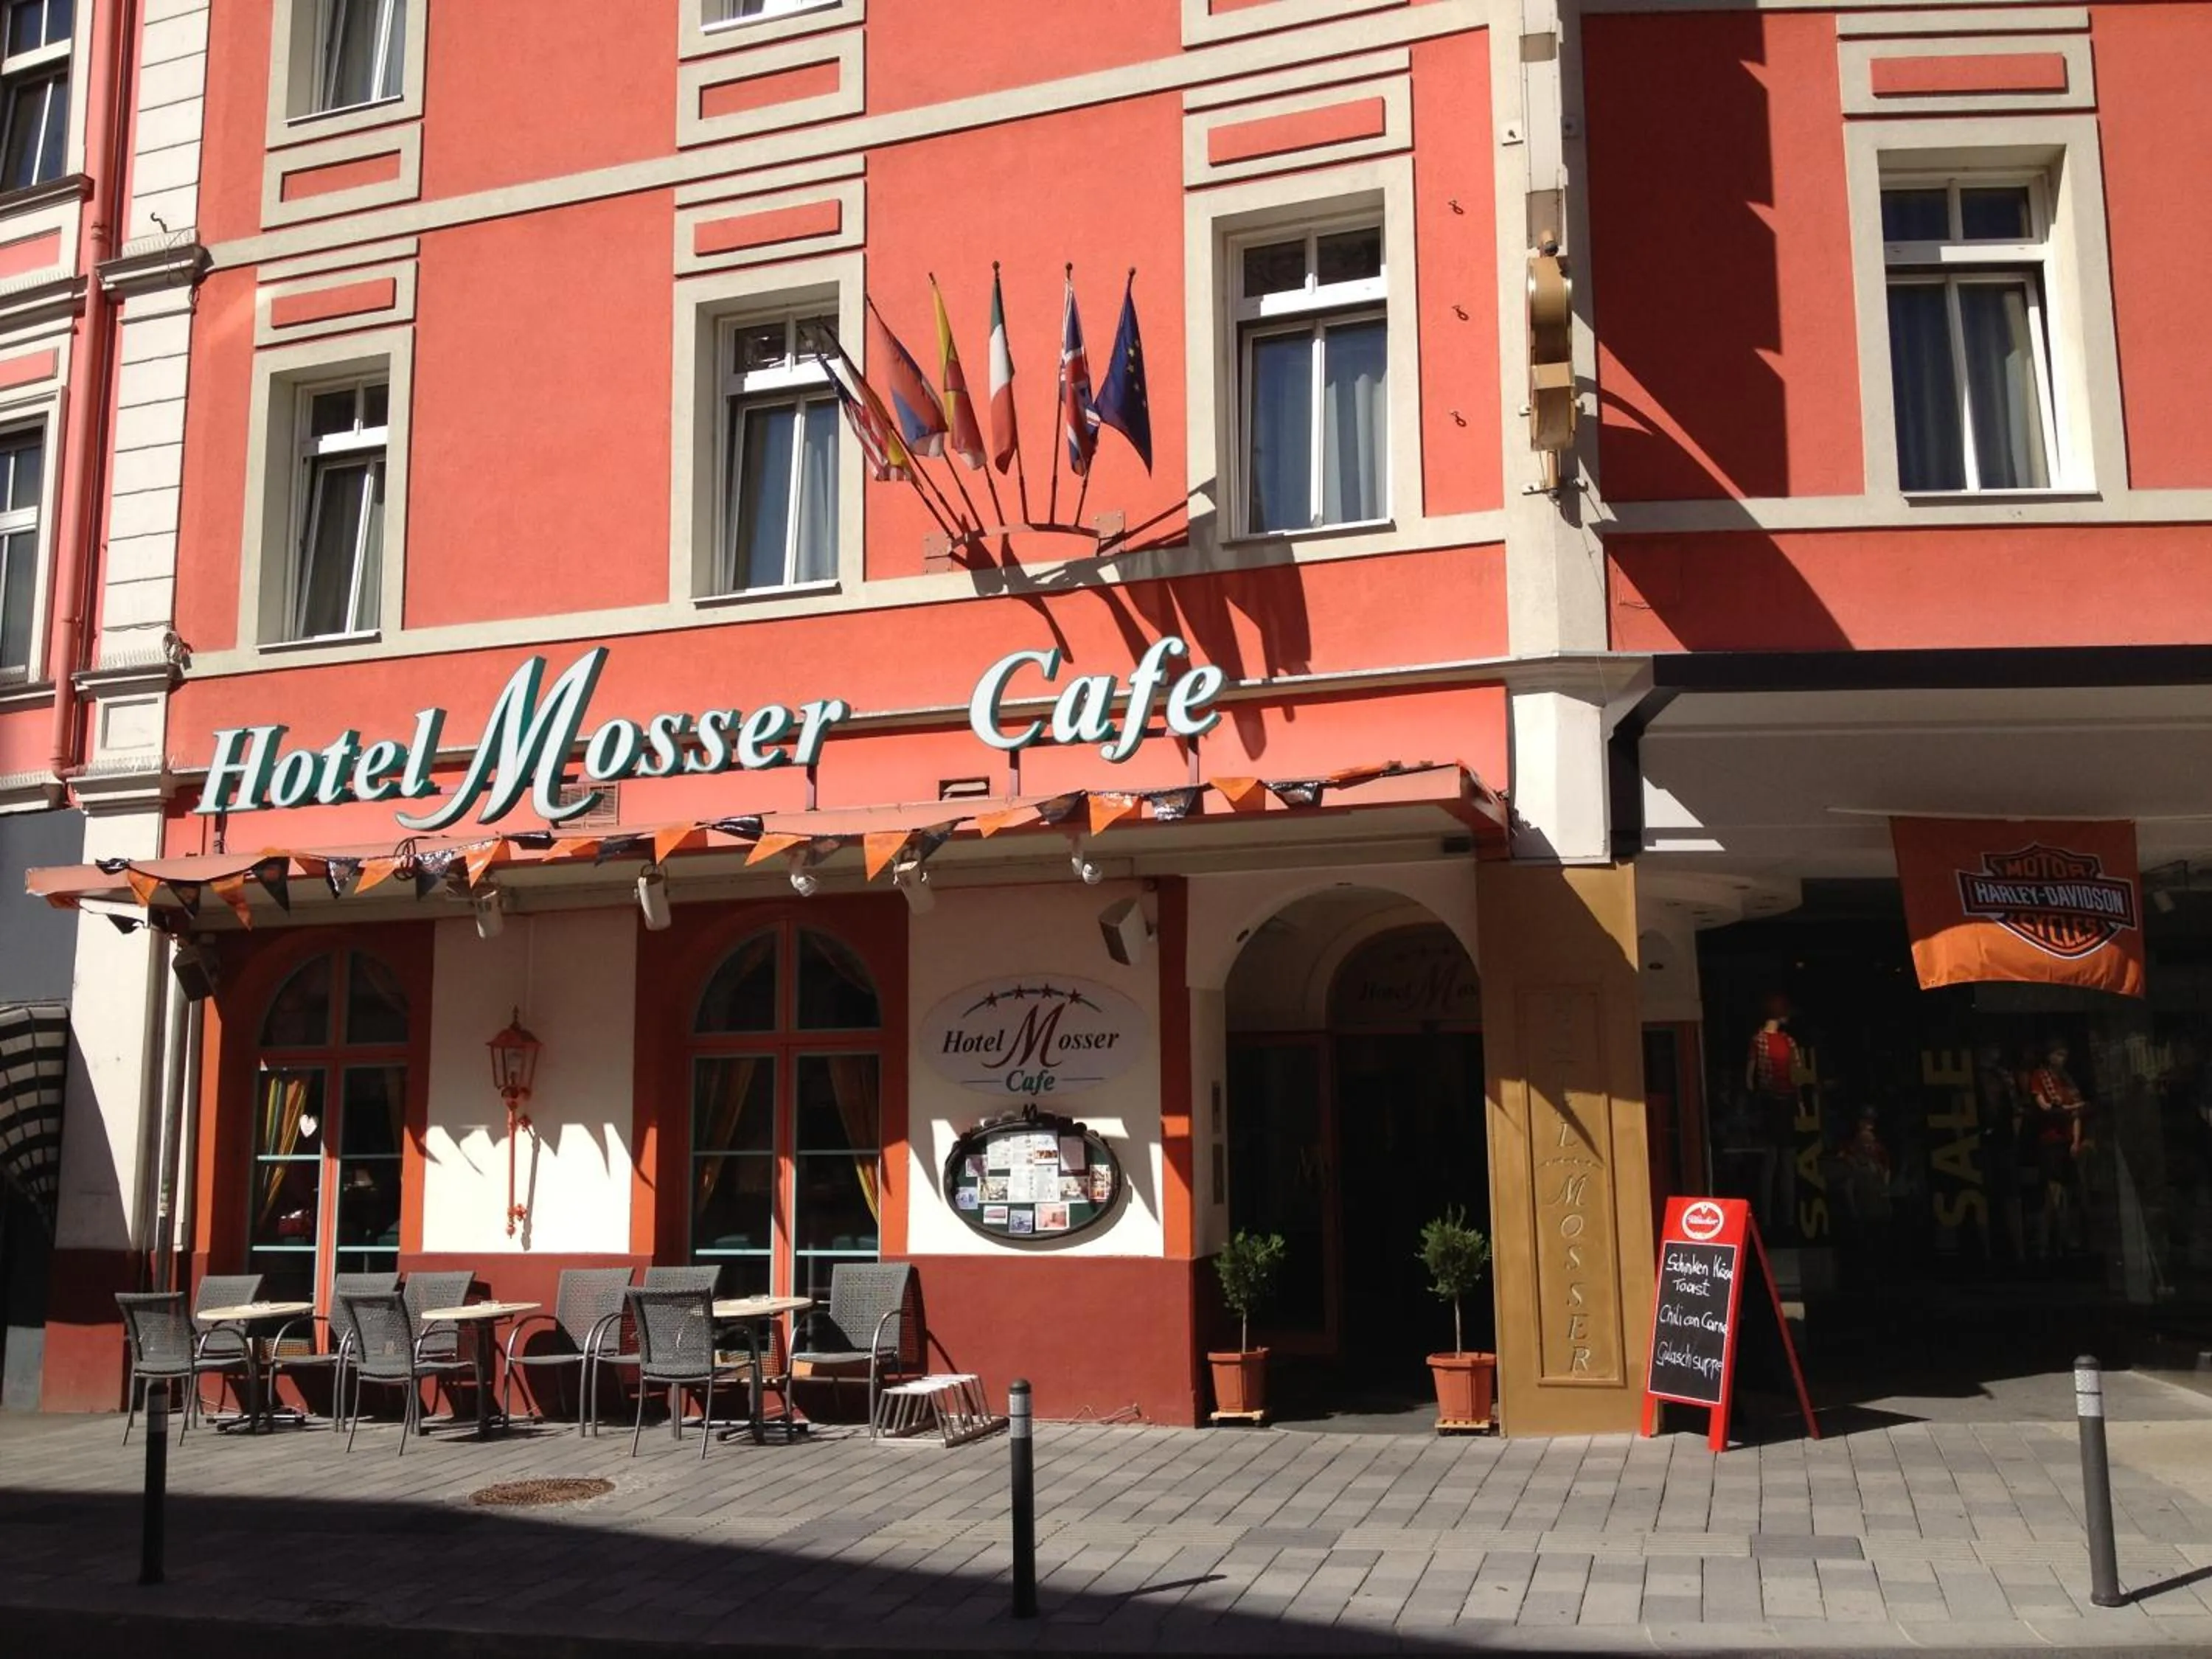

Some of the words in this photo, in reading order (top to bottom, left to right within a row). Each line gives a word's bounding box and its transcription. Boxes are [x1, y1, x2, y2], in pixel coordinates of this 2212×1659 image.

[969, 636, 1228, 764] Cafe
[193, 706, 447, 815] Hotel
[395, 646, 852, 832] Mosser
[2005, 852, 2086, 878] MOTOR
[1975, 881, 2125, 915] HARLEY-DAVIDSON
[2020, 912, 2102, 947] CYCLES
[942, 1029, 1005, 1054] Hotel
[981, 1002, 1120, 1068] Mosser
[1005, 1069, 1056, 1096] Cafe
[1920, 1048, 1990, 1229] SALE
[1543, 1172, 1590, 1372] MOSSER
[1672, 1278, 1711, 1297] Toast
[1659, 1303, 1683, 1326] Chili
